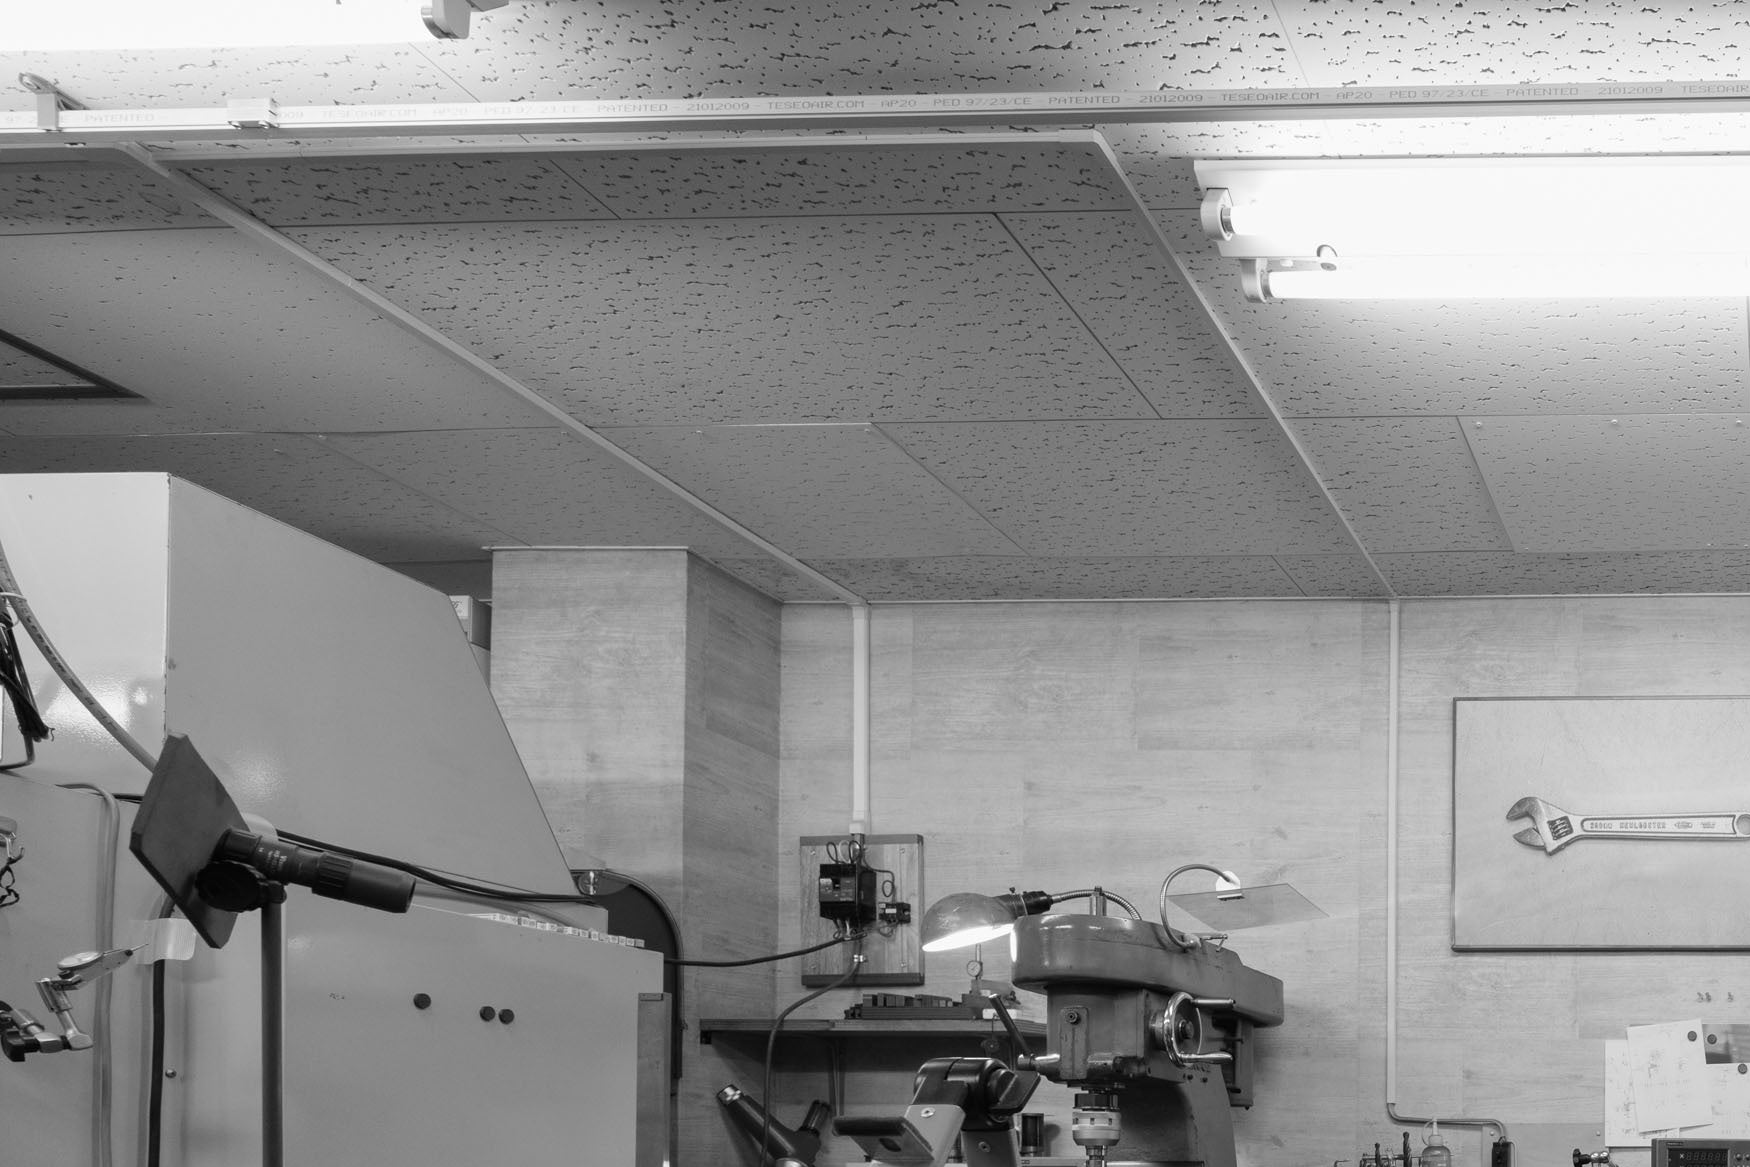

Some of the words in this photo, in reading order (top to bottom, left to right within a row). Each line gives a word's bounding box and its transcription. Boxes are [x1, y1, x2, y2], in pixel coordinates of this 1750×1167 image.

[597, 103, 668, 113] PATENTED
[686, 101, 749, 112] 21012009
[881, 98, 917, 108] AP20
[933, 97, 961, 107] PED
[966, 96, 1032, 106] 97/23/CE
[1048, 94, 1120, 105] PATENTED
[1139, 93, 1203, 103] 21012009
[1336, 89, 1372, 99] AP20
[1389, 88, 1417, 98] PED
[1422, 87, 1489, 98] 97/23/CE
[1506, 85, 1579, 96] PATENTED
[1598, 84, 1663, 94] 21012009
